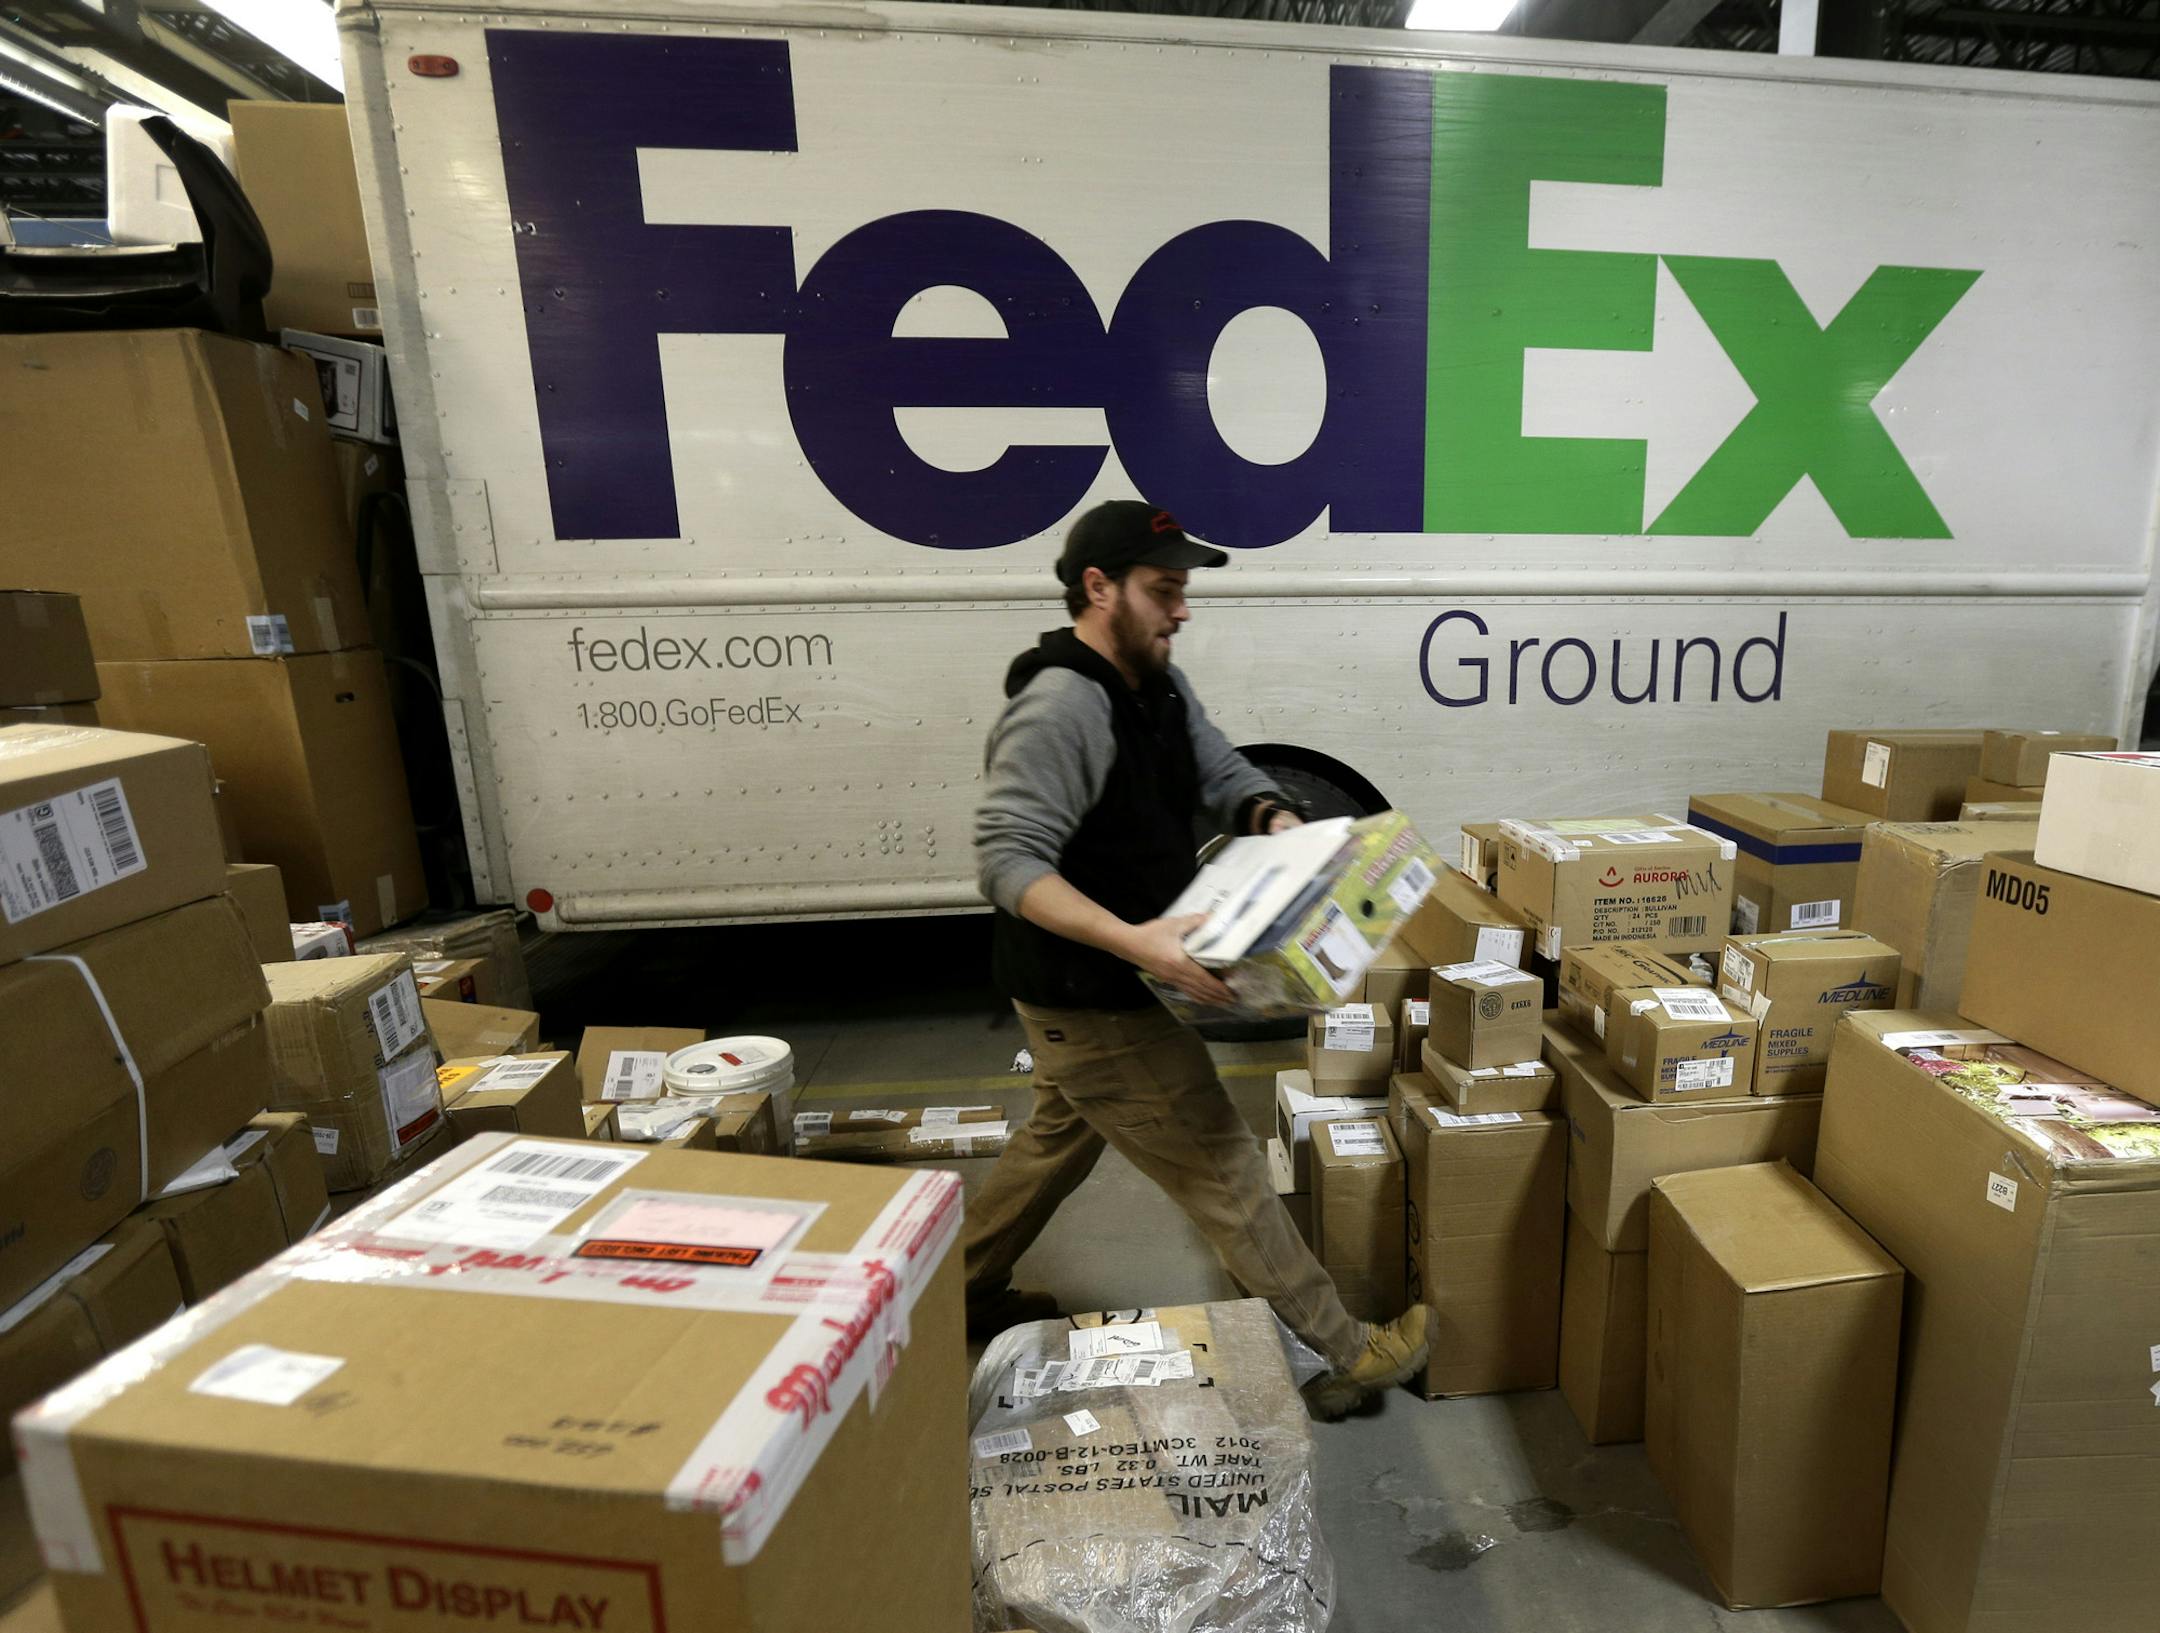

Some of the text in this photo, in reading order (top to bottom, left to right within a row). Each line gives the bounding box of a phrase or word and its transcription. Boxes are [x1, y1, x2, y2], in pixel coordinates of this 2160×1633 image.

[485, 28, 1984, 550] FedEx
[567, 626, 833, 672] fedex.com
[1419, 609, 1787, 708] Ground
[577, 697, 803, 729] 1.800.GoFedEx
[1633, 871, 1687, 884] AURORA
[1986, 869, 2050, 915] MD05
[1593, 898, 1617, 906] ITEM
[1593, 906, 1639, 914] DESCRIPTION
[1592, 934, 1612, 942] MADE
[1621, 933, 1657, 941] INDONESIA
[1818, 987, 1891, 1003] MEDLINE
[1770, 1027, 1814, 1039] FRAGILE
[1700, 1037, 1751, 1050] MEDLINE
[1767, 1039, 1797, 1049] MIXED
[1767, 1047, 1809, 1057] SUPPLIES
[1215, 1436, 1262, 1450] 2012
[1056, 1453, 1262, 1476] TARE WT. 0.32 LBS.
[1004, 1480, 1090, 1497] POSTAL
[1096, 1477, 1180, 1491] STATES
[1188, 1473, 1265, 1489] UNITED
[1165, 1488, 1269, 1518] MAIL
[160, 1537, 371, 1605] HELMET
[386, 1564, 609, 1631] DISPLAY
